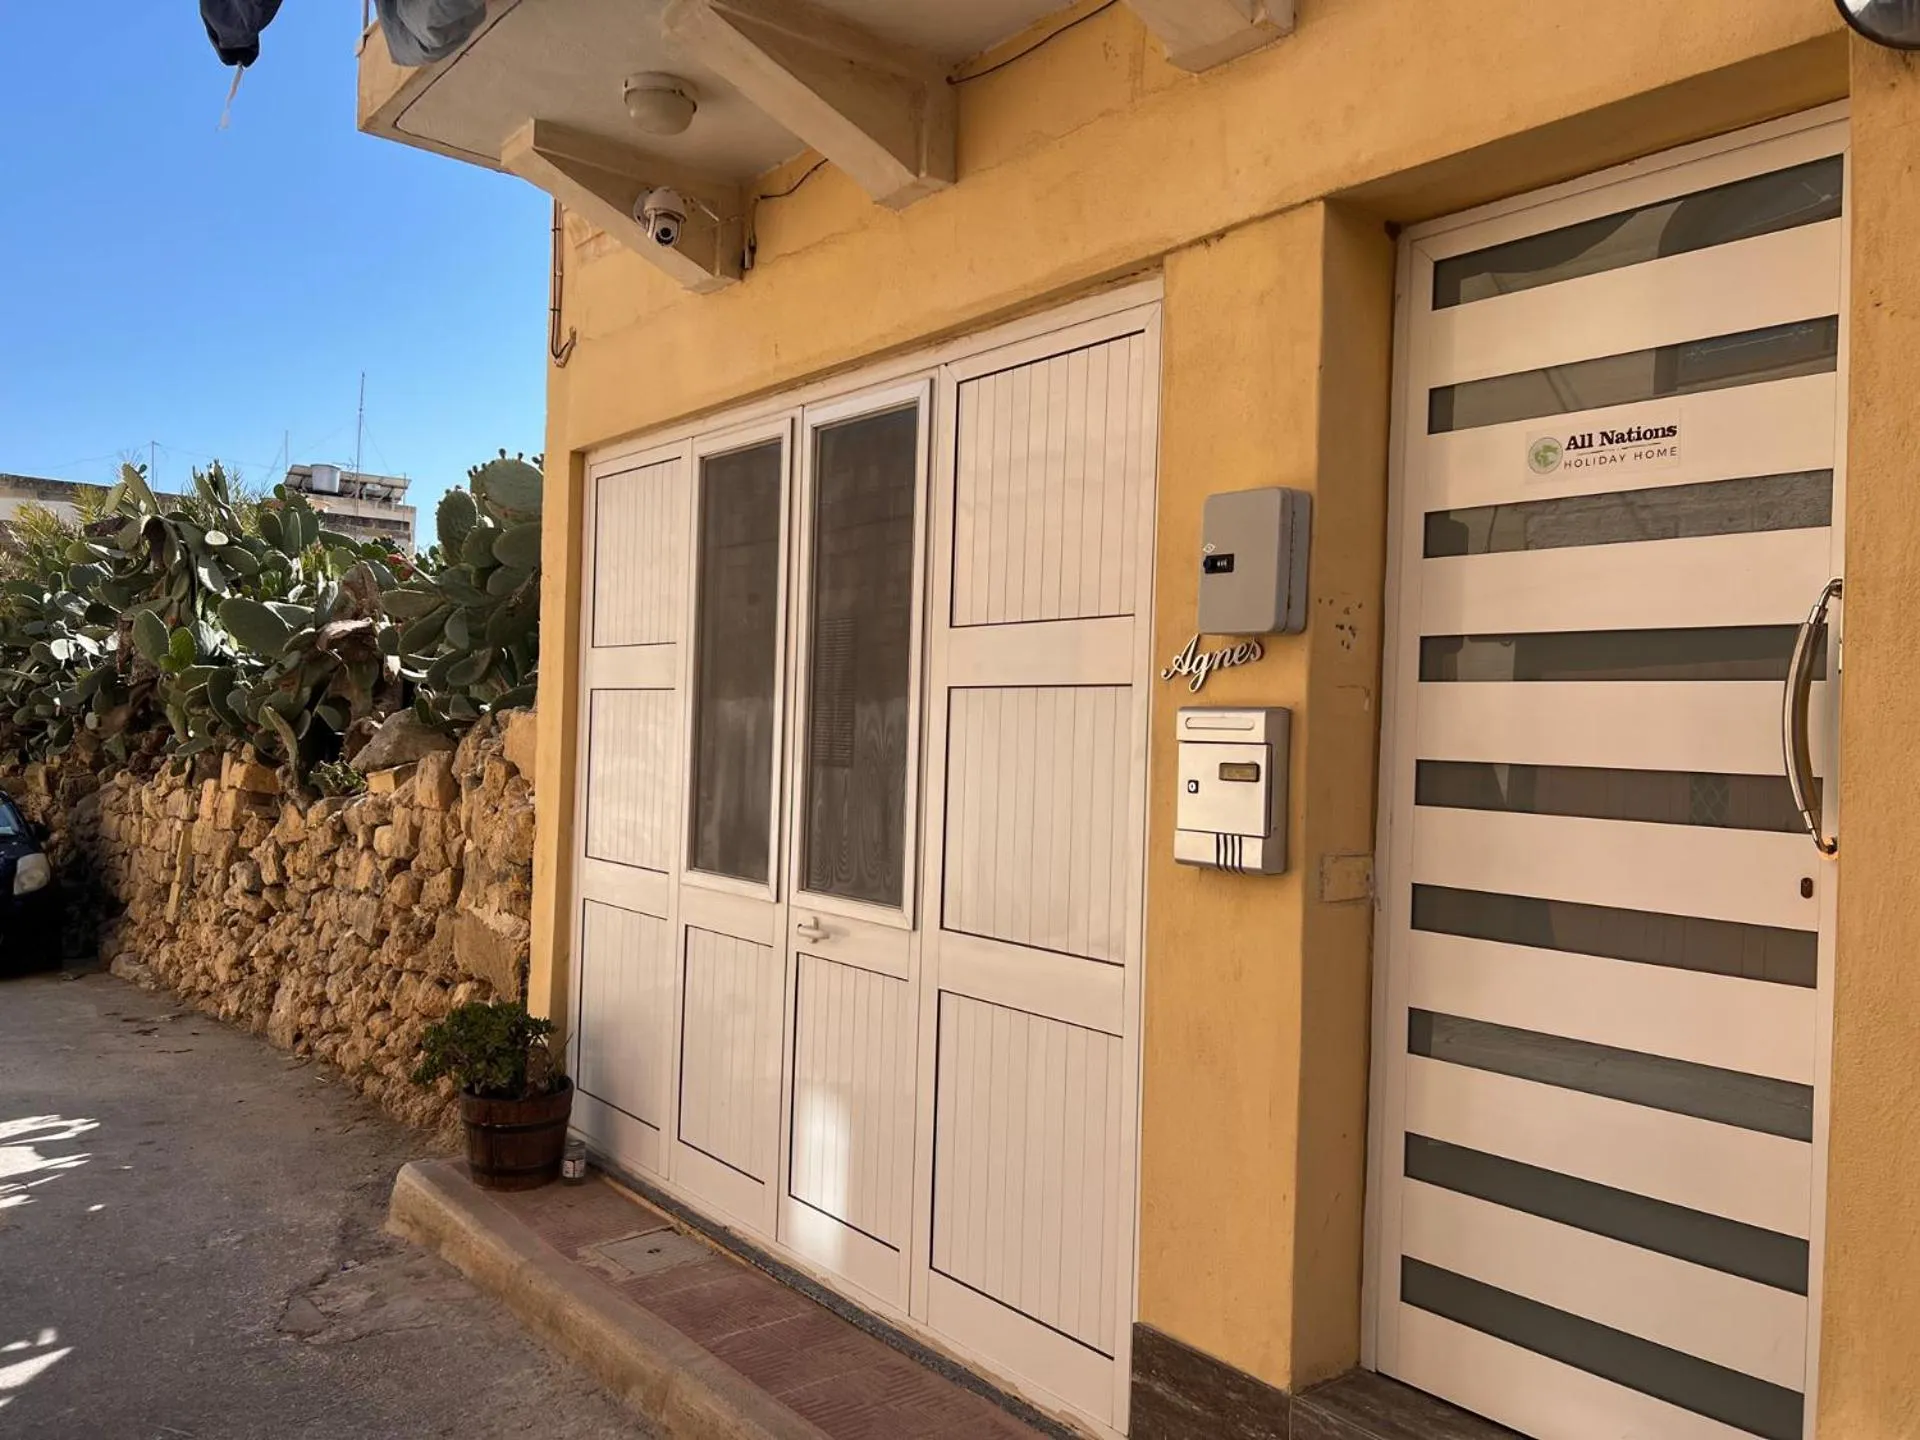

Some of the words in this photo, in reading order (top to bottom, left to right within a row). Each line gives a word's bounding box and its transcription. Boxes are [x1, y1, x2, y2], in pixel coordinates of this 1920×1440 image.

[1565, 435, 1594, 451] All
[1600, 425, 1678, 446] Nations
[1563, 453, 1626, 469] HOLIDAY
[1633, 446, 1678, 461] HOME
[1160, 633, 1263, 693] Agnes
